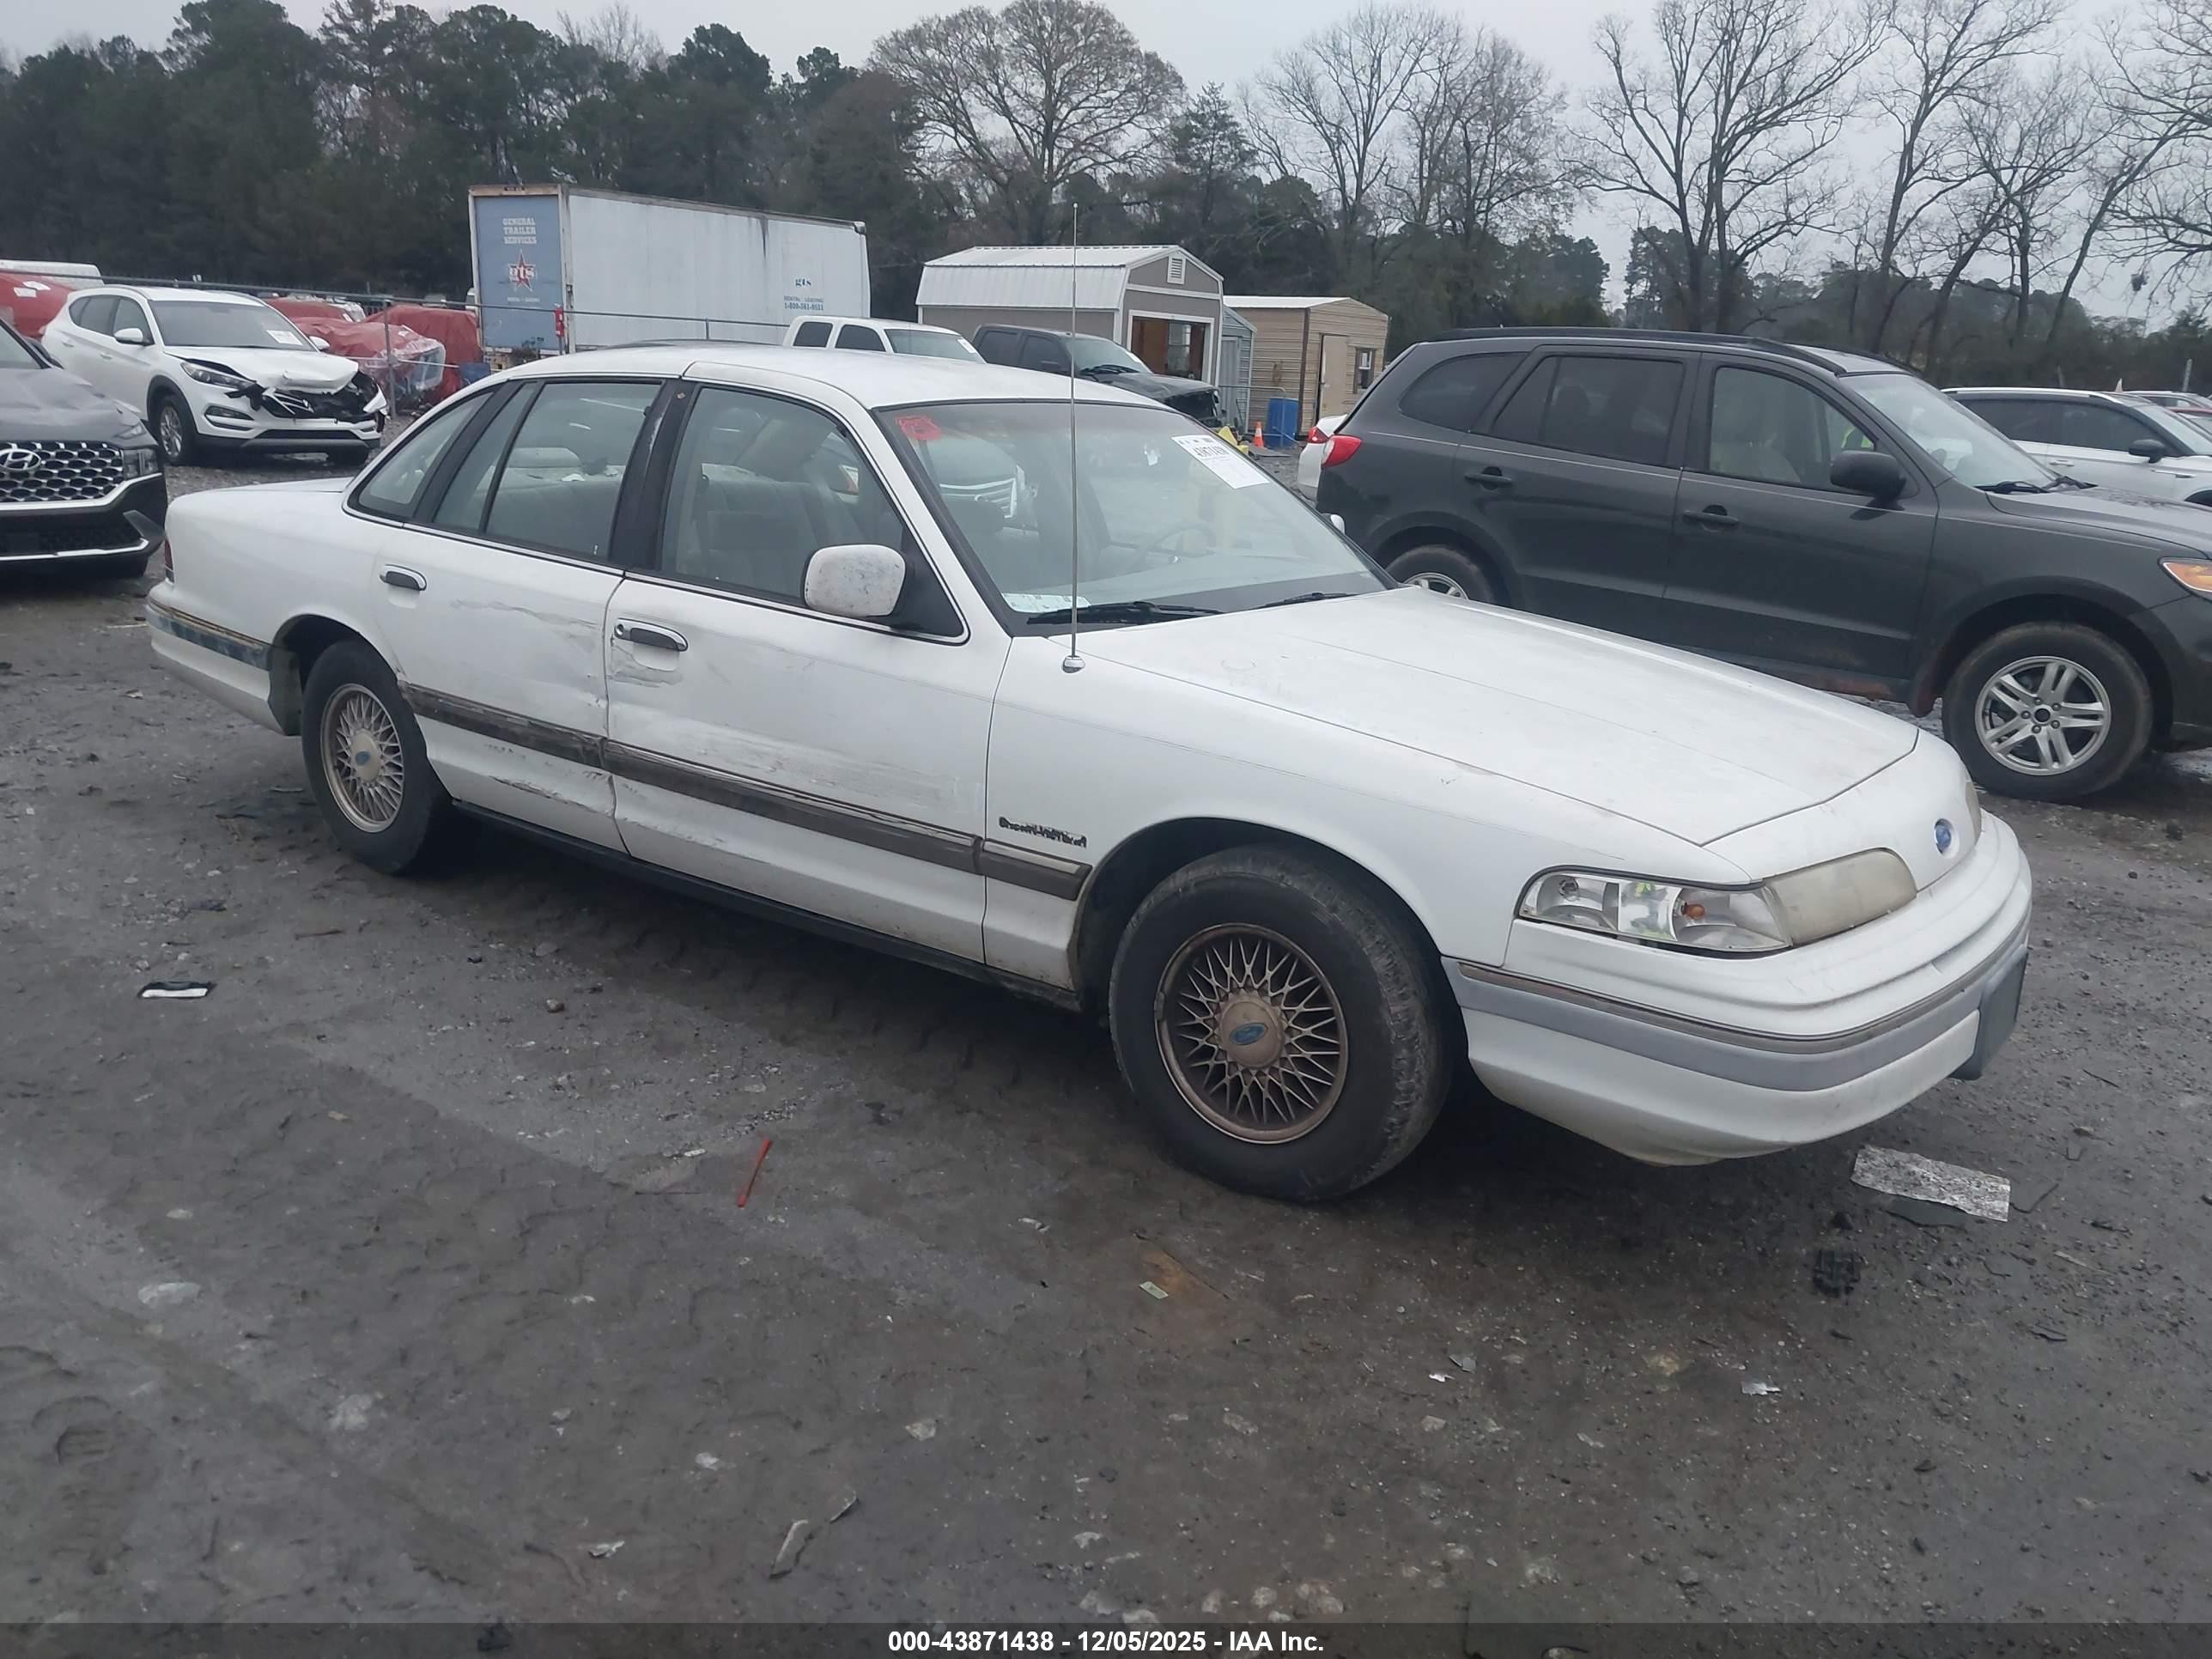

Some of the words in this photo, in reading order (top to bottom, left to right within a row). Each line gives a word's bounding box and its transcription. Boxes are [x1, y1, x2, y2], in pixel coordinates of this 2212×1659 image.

[502, 217, 536, 226] GENERAL
[502, 226, 537, 235] TRAILER
[503, 236, 538, 245] SERVICES
[795, 278, 811, 287] gts
